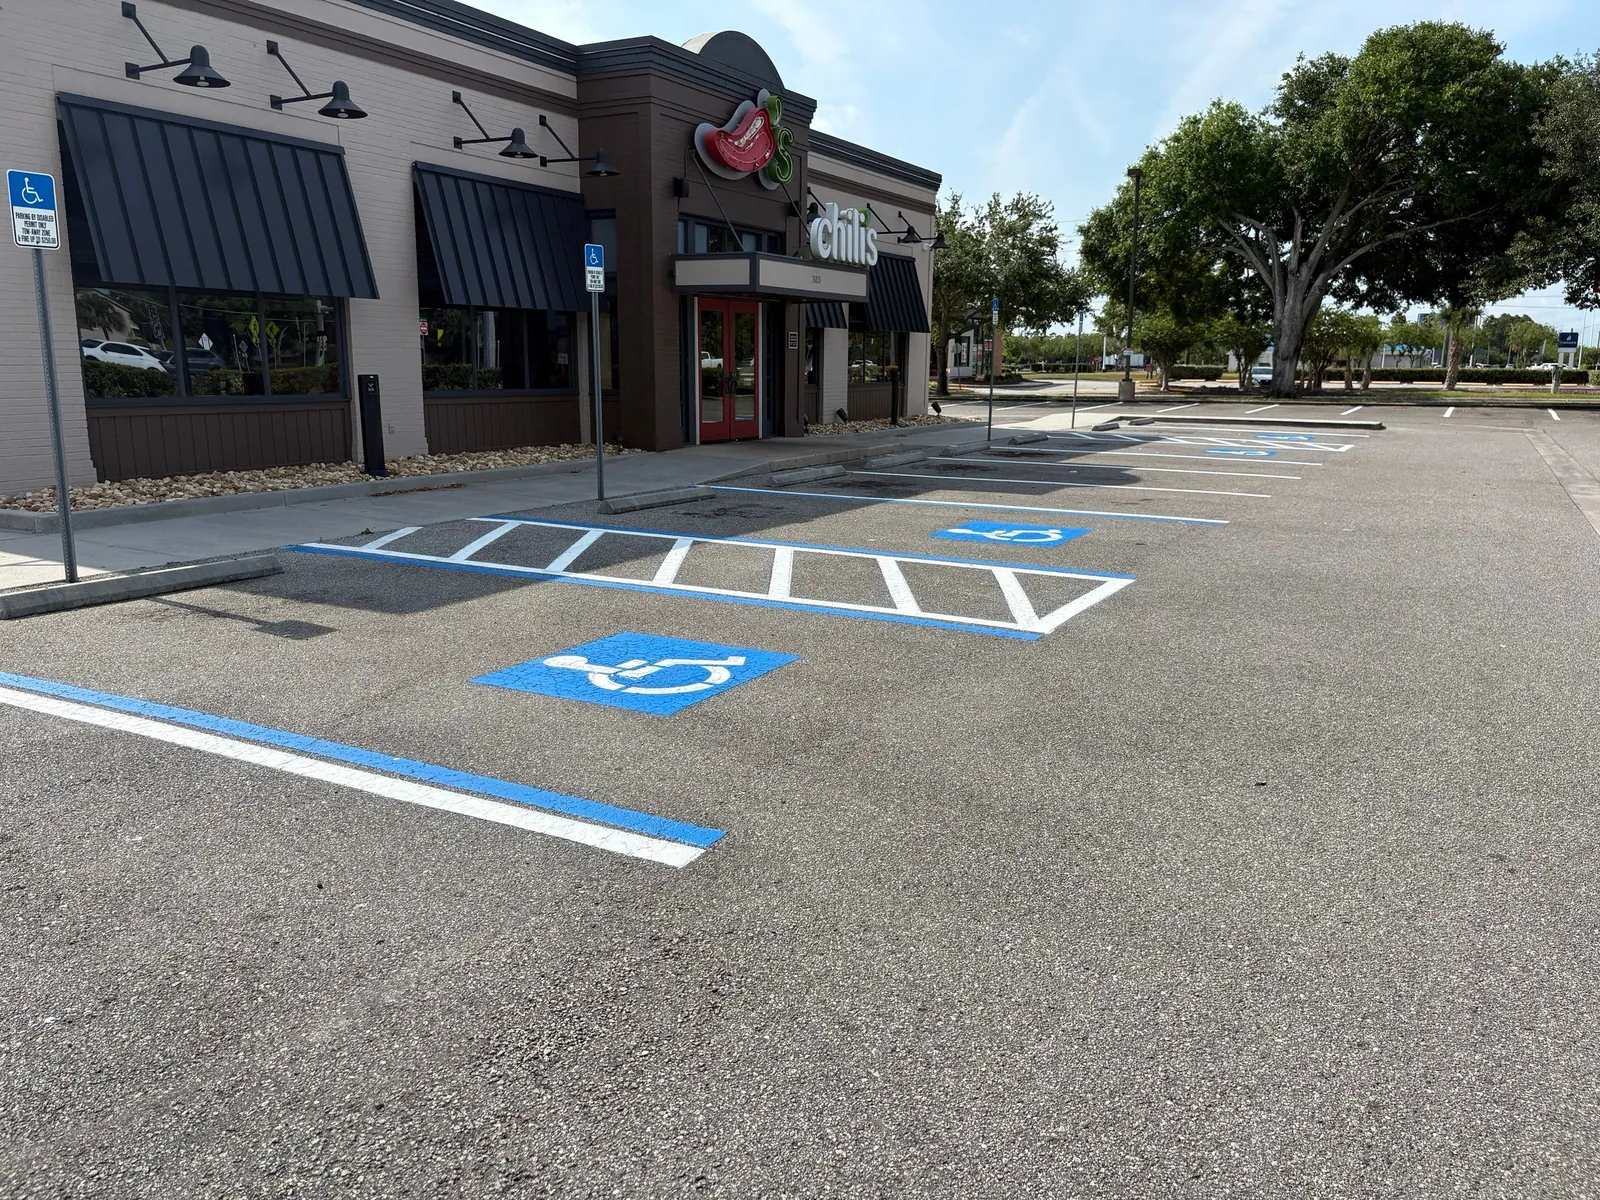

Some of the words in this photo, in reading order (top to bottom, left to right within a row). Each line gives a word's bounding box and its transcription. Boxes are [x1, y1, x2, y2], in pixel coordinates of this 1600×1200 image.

[15, 212, 30, 220] PARKING
[37, 214, 54, 222] DISABLED
[24, 220, 37, 228] PERMIT
[41, 229, 51, 237] ZONE
[811, 275, 821, 284] 303
